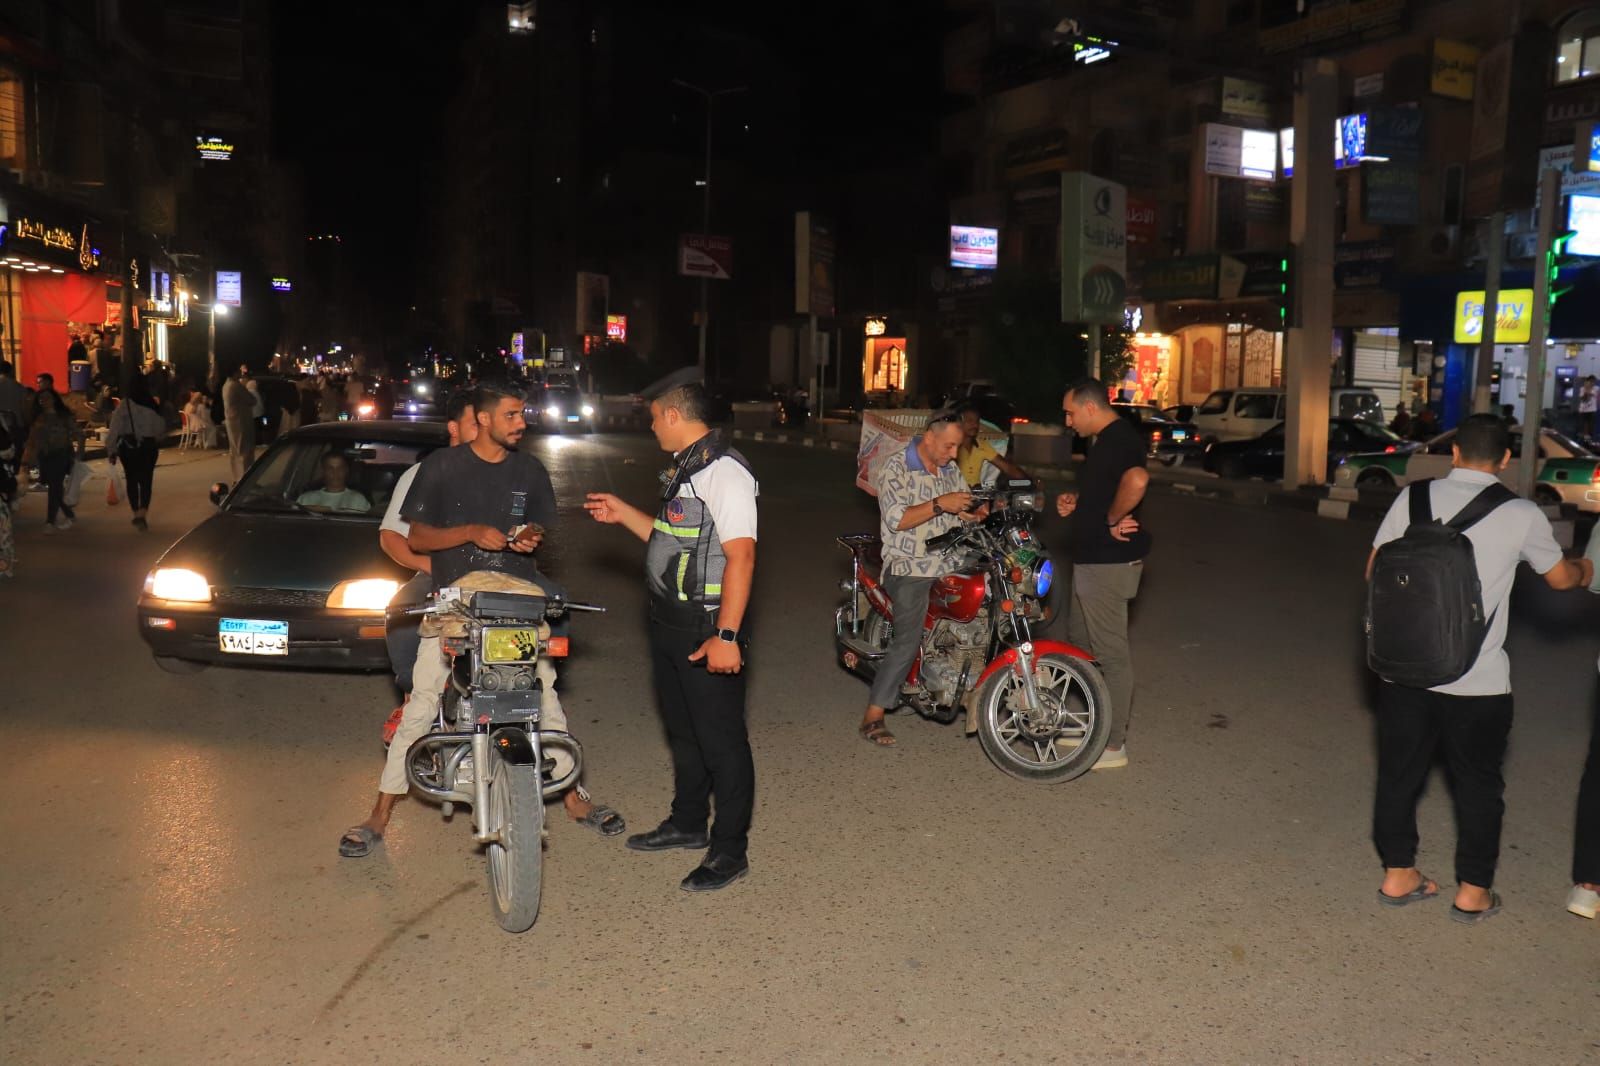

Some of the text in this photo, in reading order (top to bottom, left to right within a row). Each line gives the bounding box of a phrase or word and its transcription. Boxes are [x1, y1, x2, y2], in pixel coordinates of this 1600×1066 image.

[952, 234, 969, 246] لاب
[1494, 313, 1520, 330] lus
[225, 621, 247, 630] EGYPT
